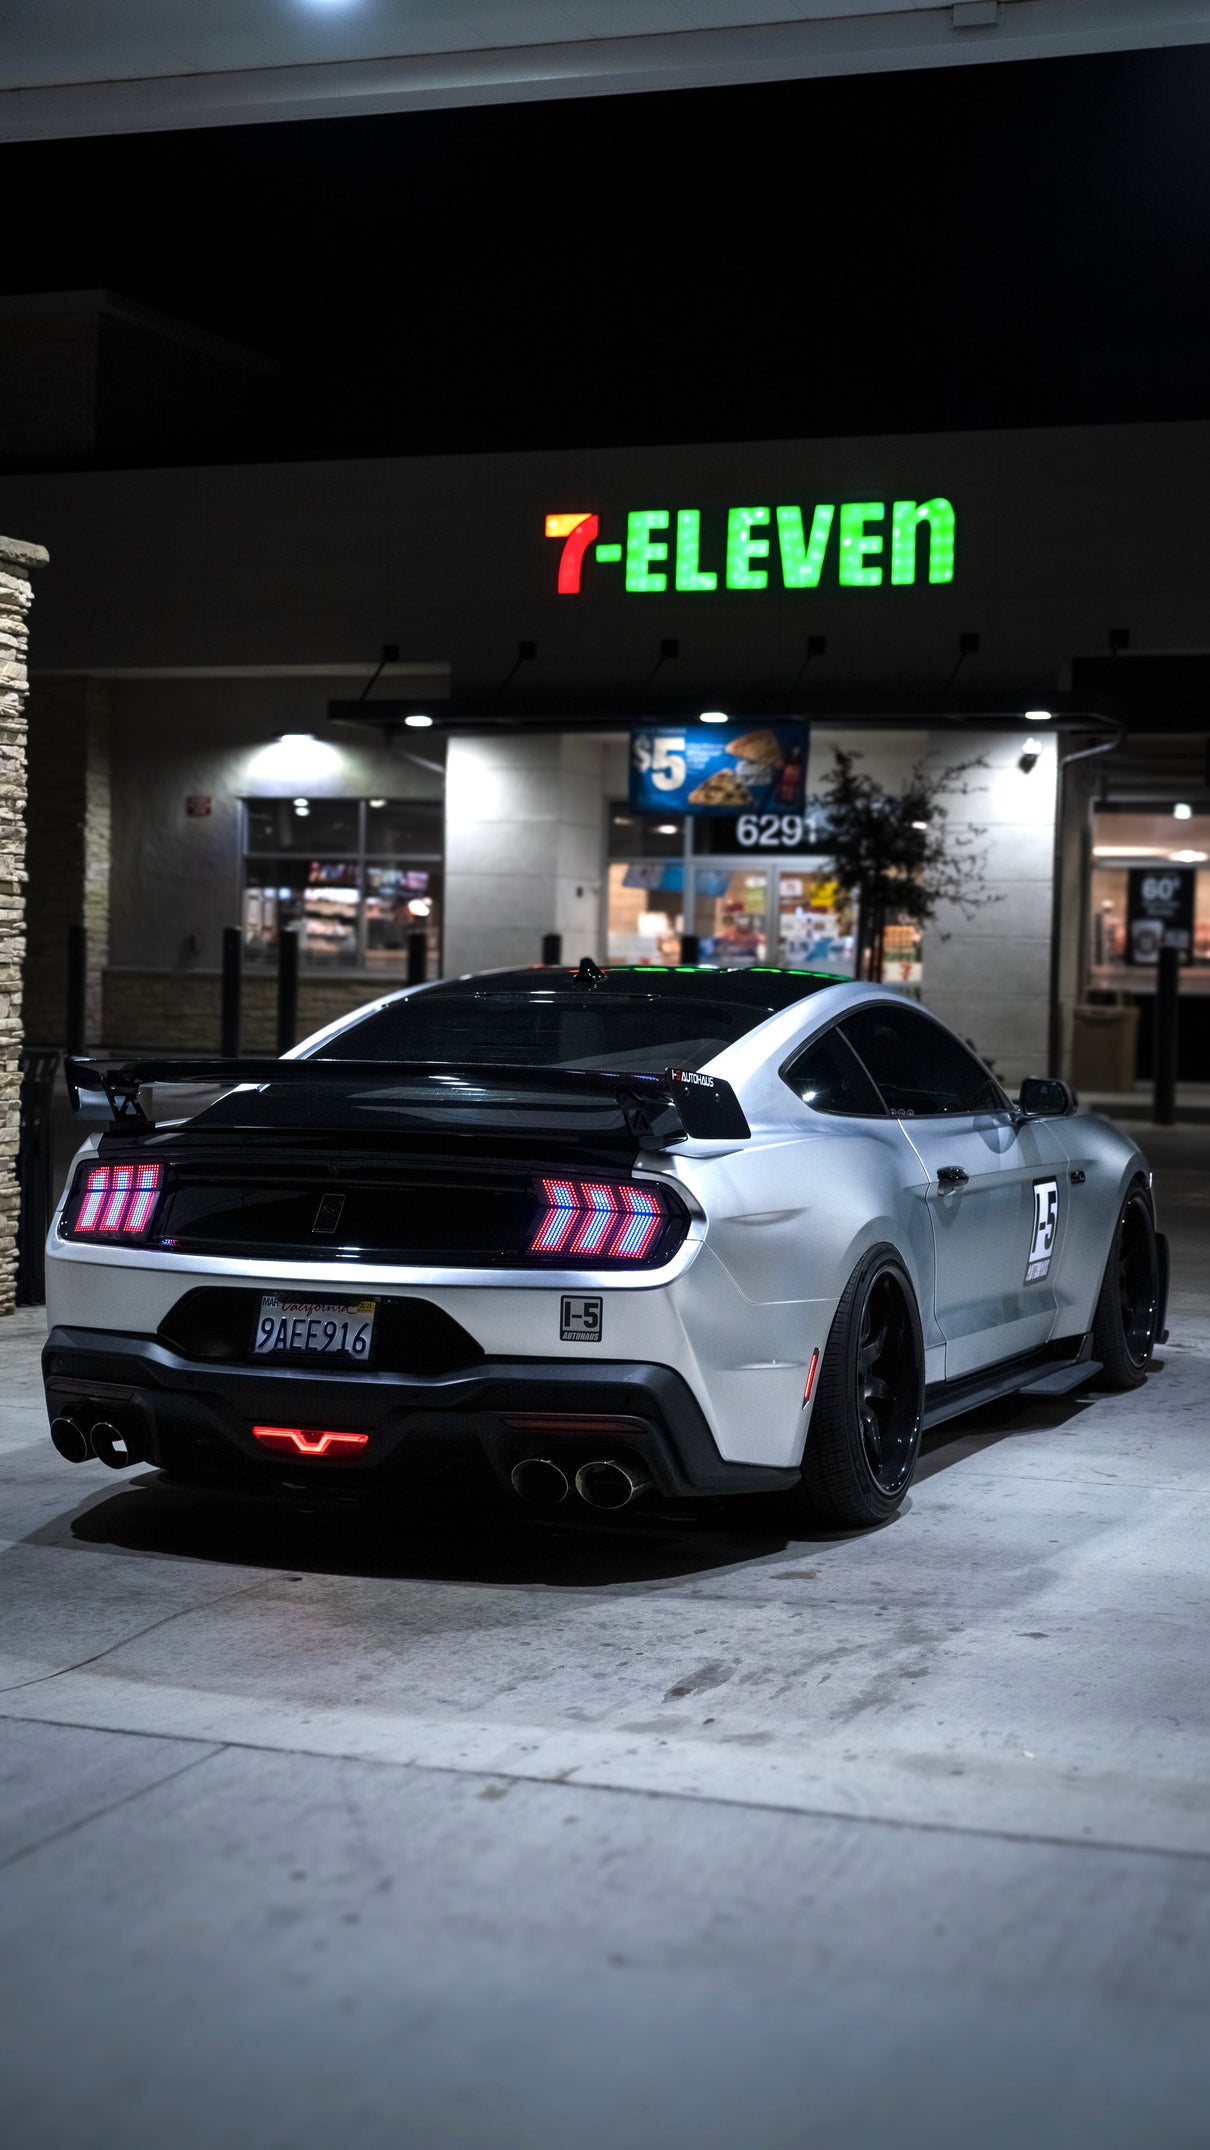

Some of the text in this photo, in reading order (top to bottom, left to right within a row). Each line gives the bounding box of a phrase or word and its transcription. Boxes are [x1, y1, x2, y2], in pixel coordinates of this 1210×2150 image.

[545, 497, 955, 594] 7-ELEVEn
[634, 735, 686, 791] $5
[681, 1071, 714, 1087] AUTOHAUS
[1031, 1190, 1056, 1252] I-5
[564, 1301, 599, 1328] I-5
[257, 1317, 369, 1354] 9AEE916
[562, 1331, 599, 1340] AUTOHAUS
